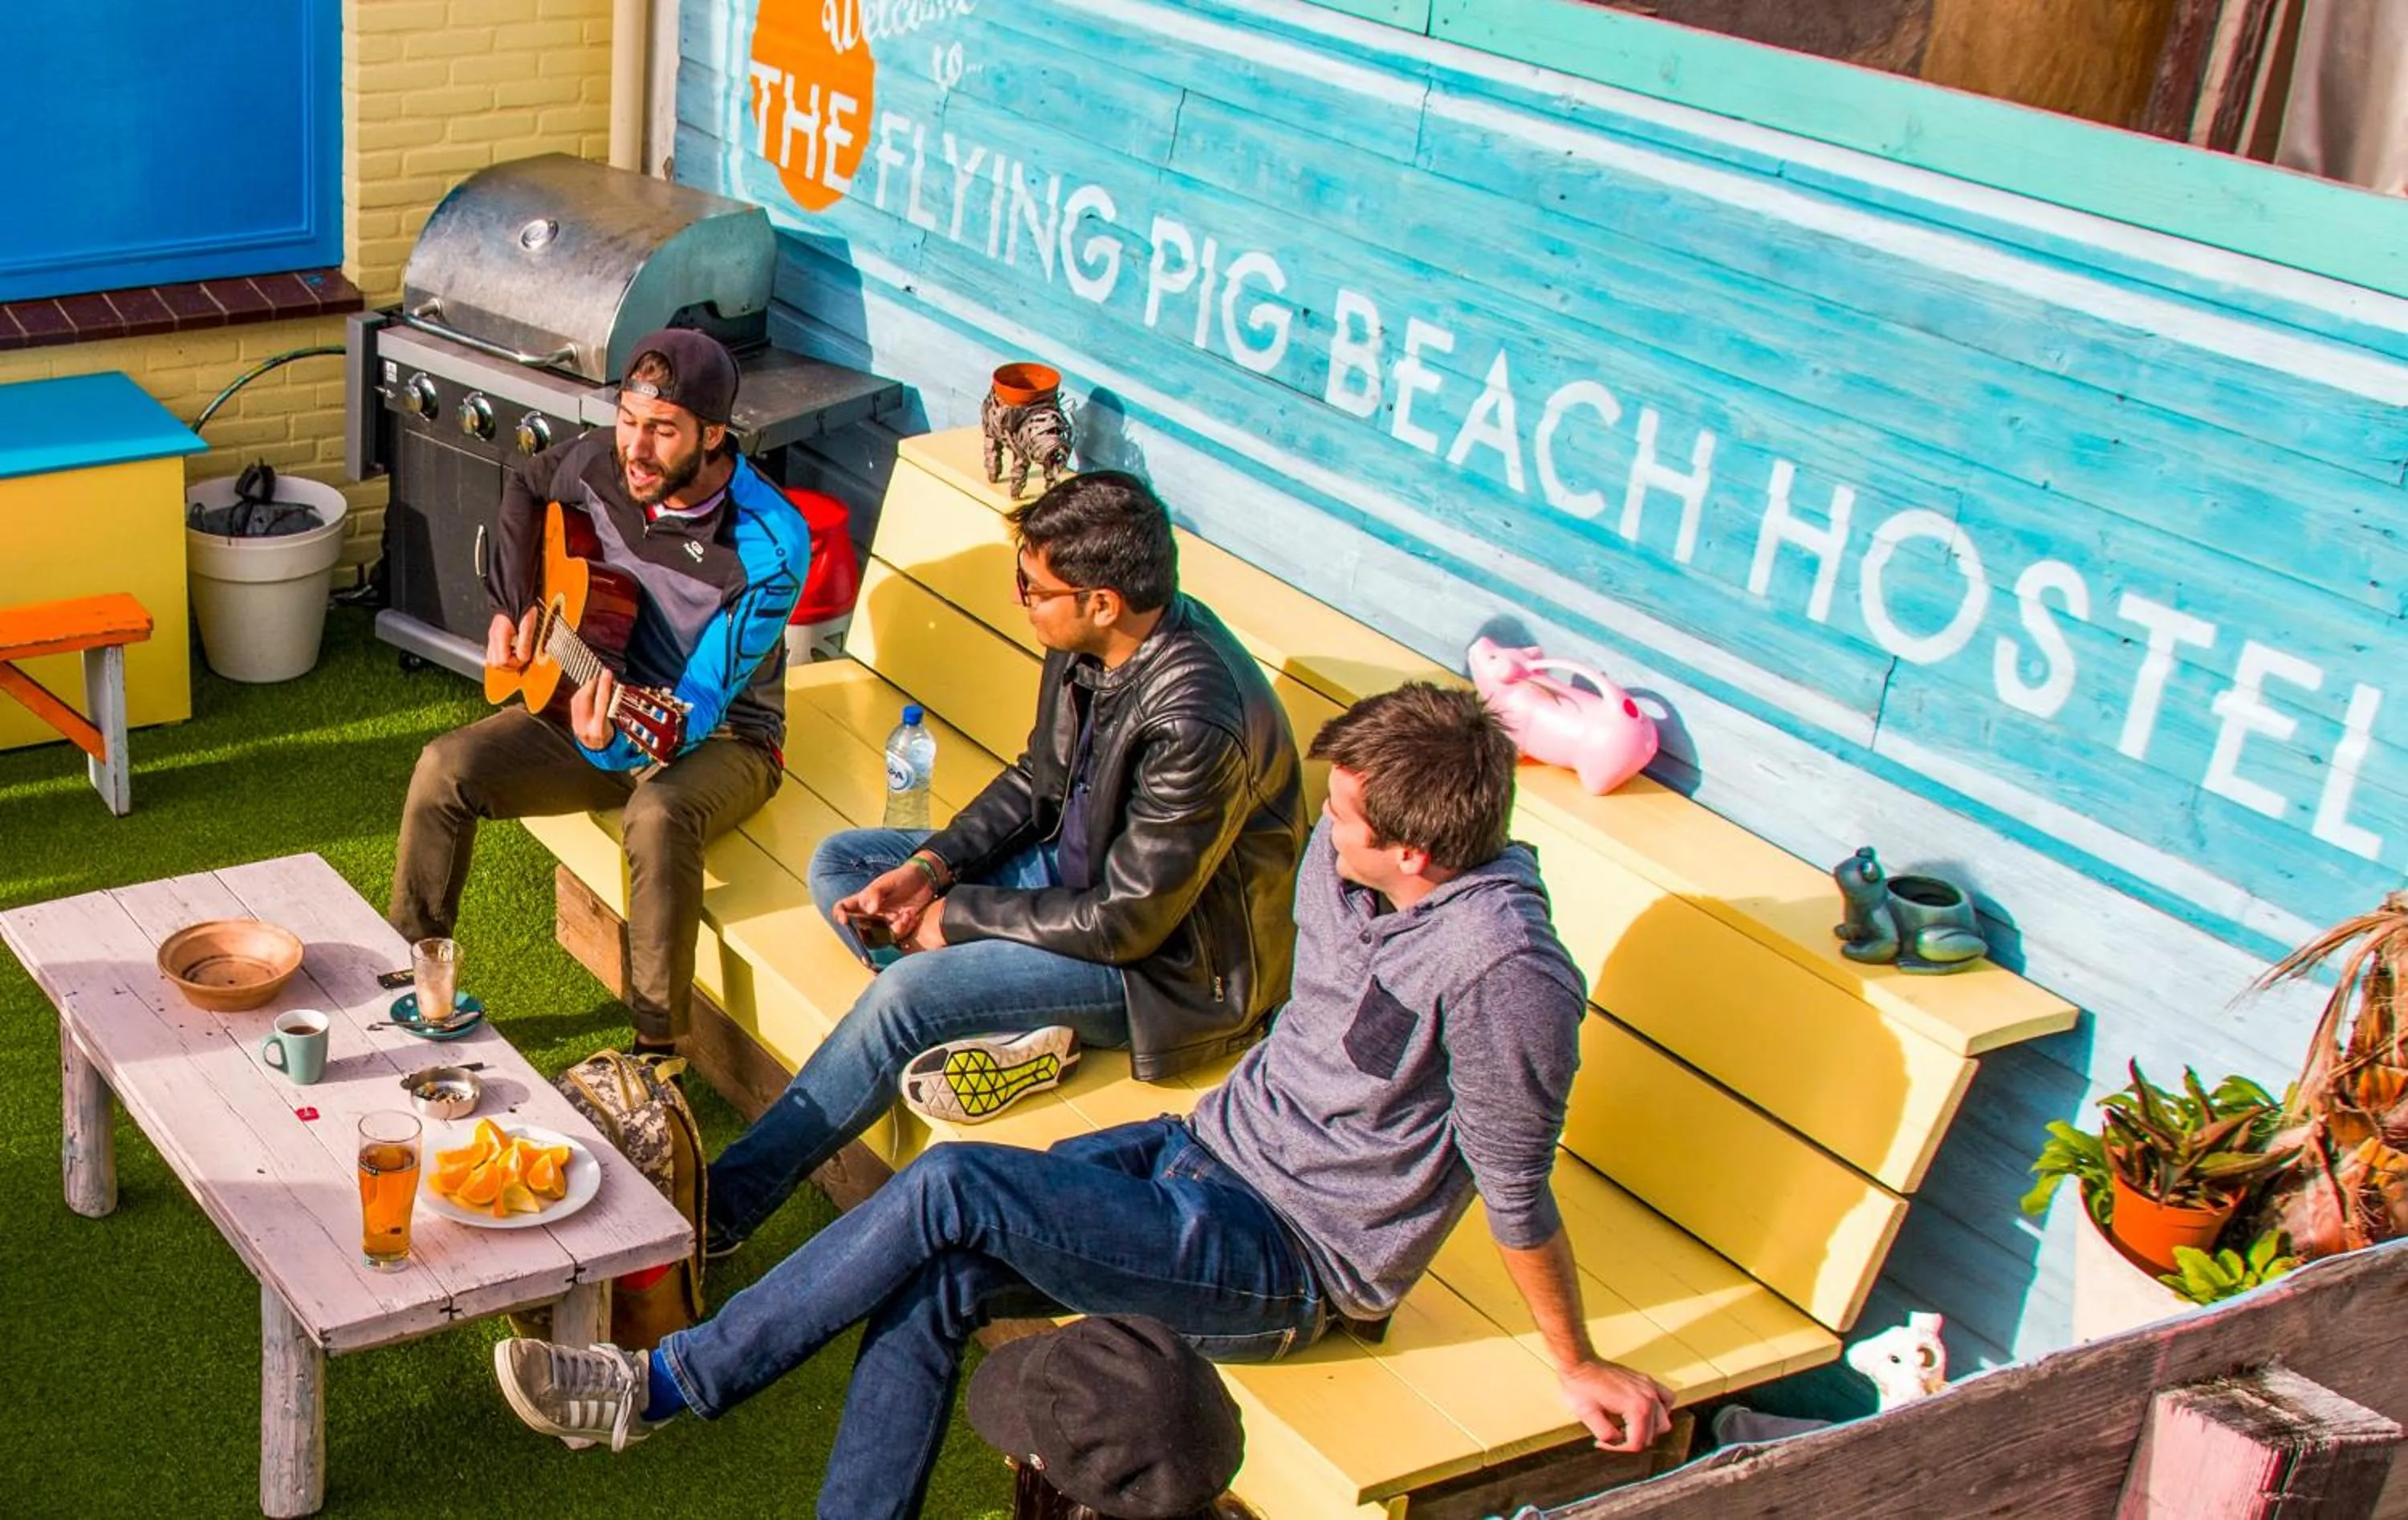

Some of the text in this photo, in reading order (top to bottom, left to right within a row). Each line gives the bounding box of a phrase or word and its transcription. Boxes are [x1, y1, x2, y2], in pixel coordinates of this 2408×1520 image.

[749, 59, 2384, 861] THE FLYING PIG BEACH HOSTEL
